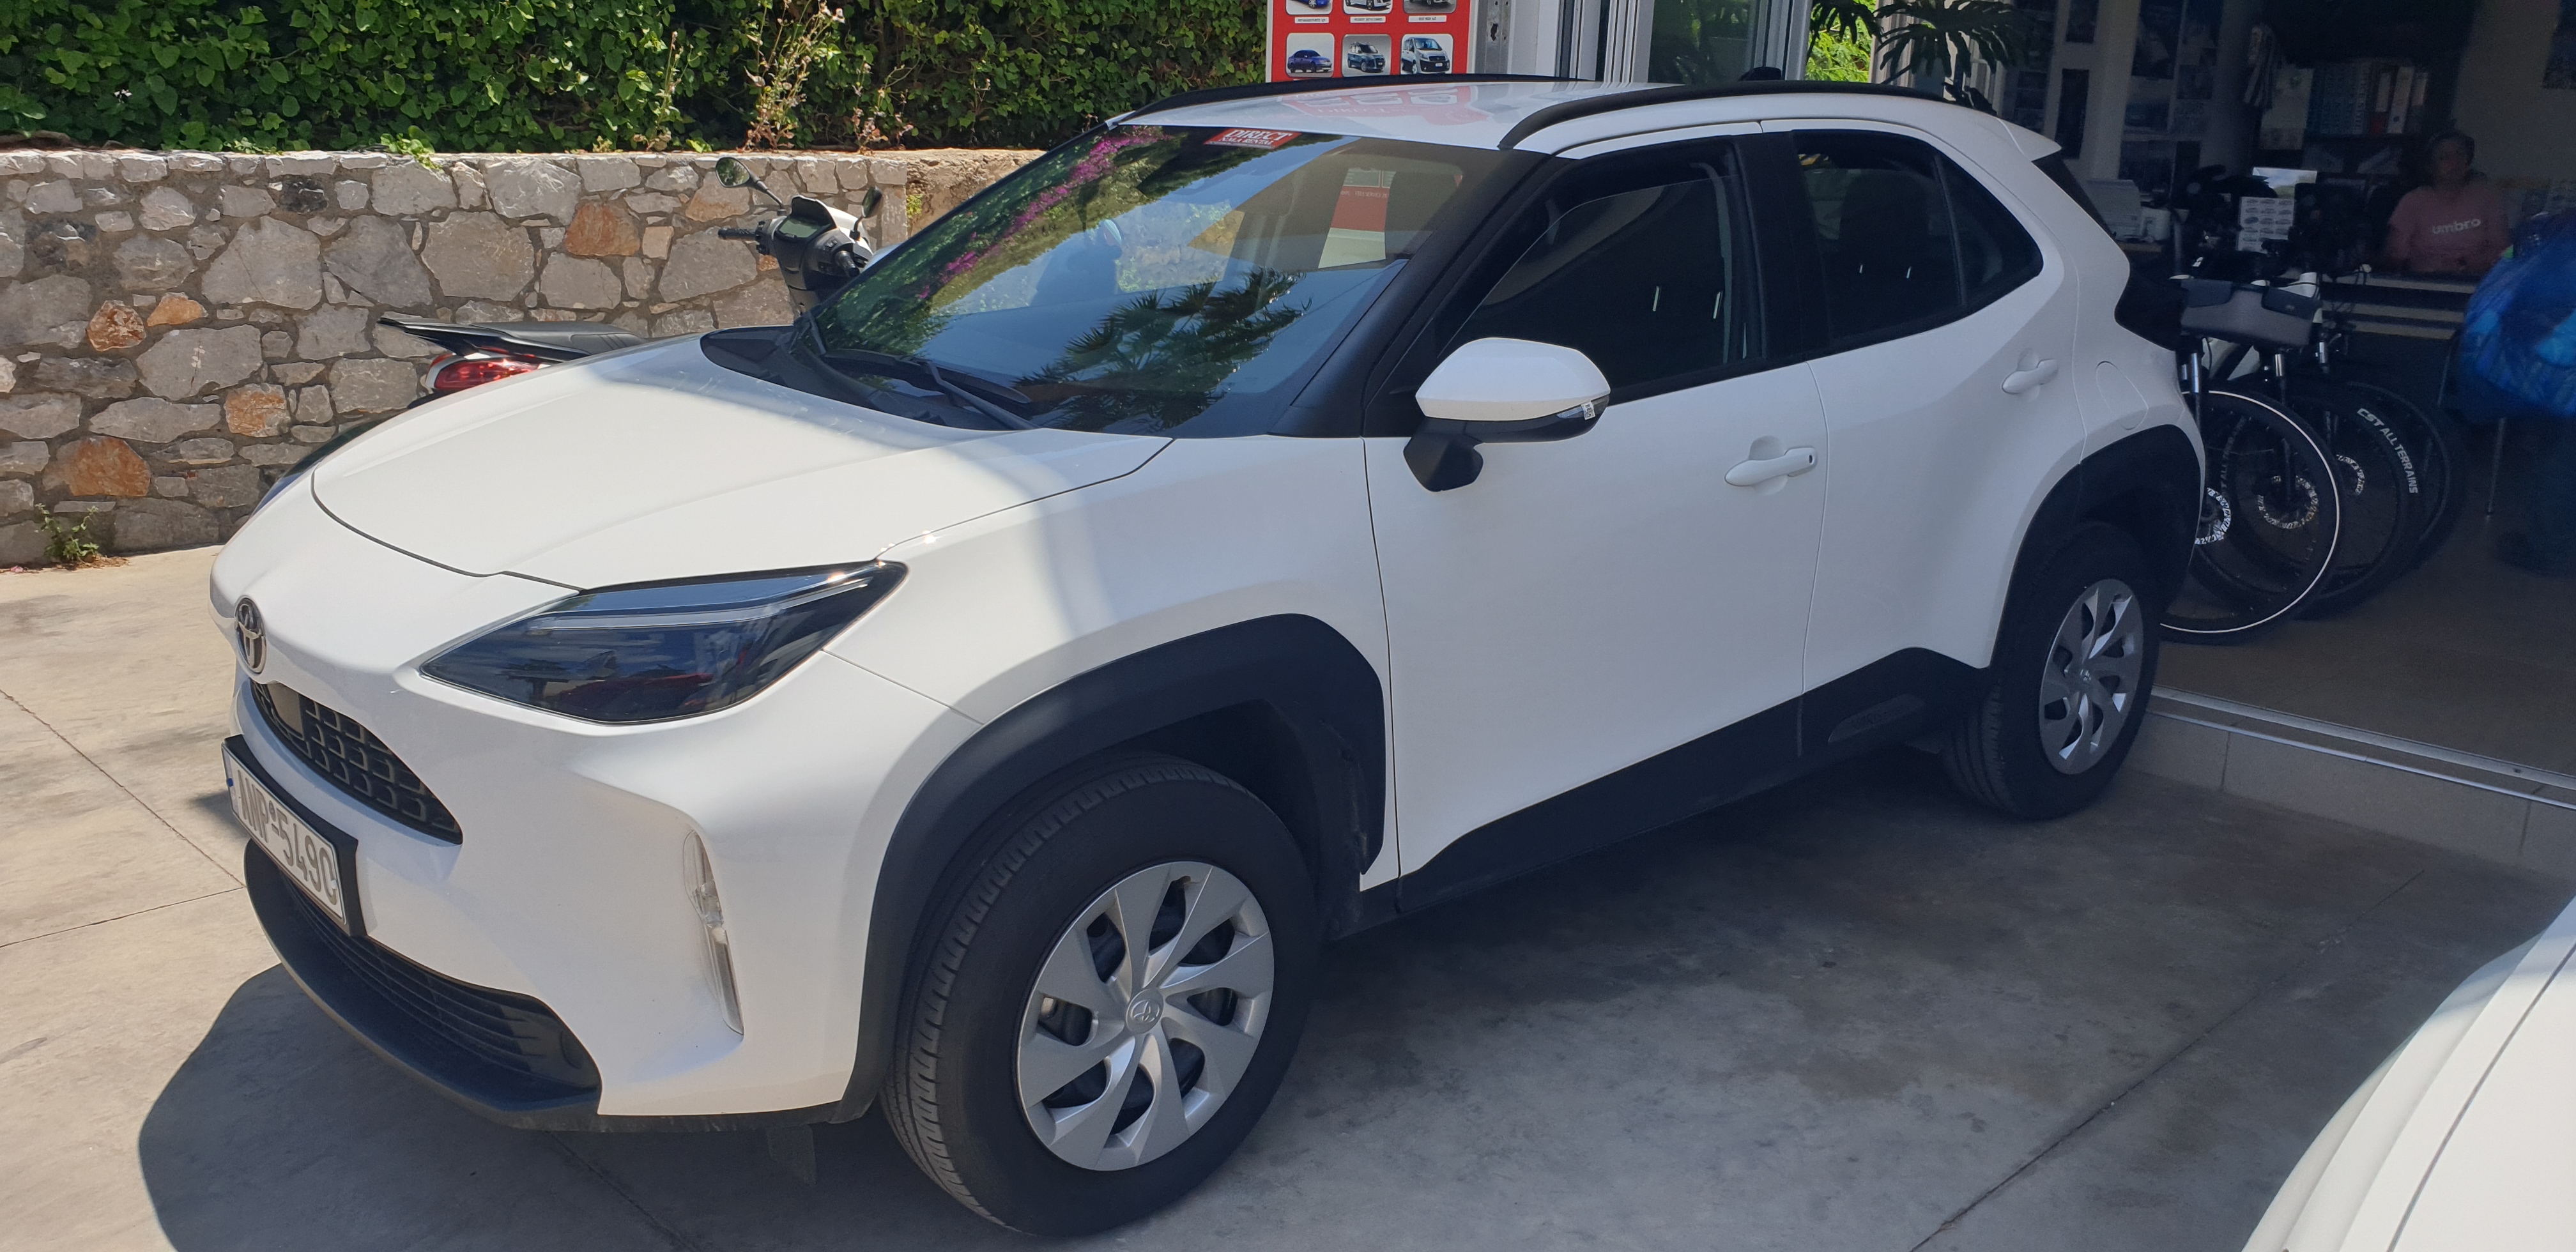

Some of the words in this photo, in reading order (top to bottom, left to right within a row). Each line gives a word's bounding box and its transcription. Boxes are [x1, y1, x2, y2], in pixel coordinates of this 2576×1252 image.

[1225, 129, 1293, 141] DIRECT
[2432, 218, 2481, 234] umbro
[2356, 408, 2385, 427] CST
[2379, 427, 2398, 446] ALL
[2394, 444, 2419, 494] TERRAINS
